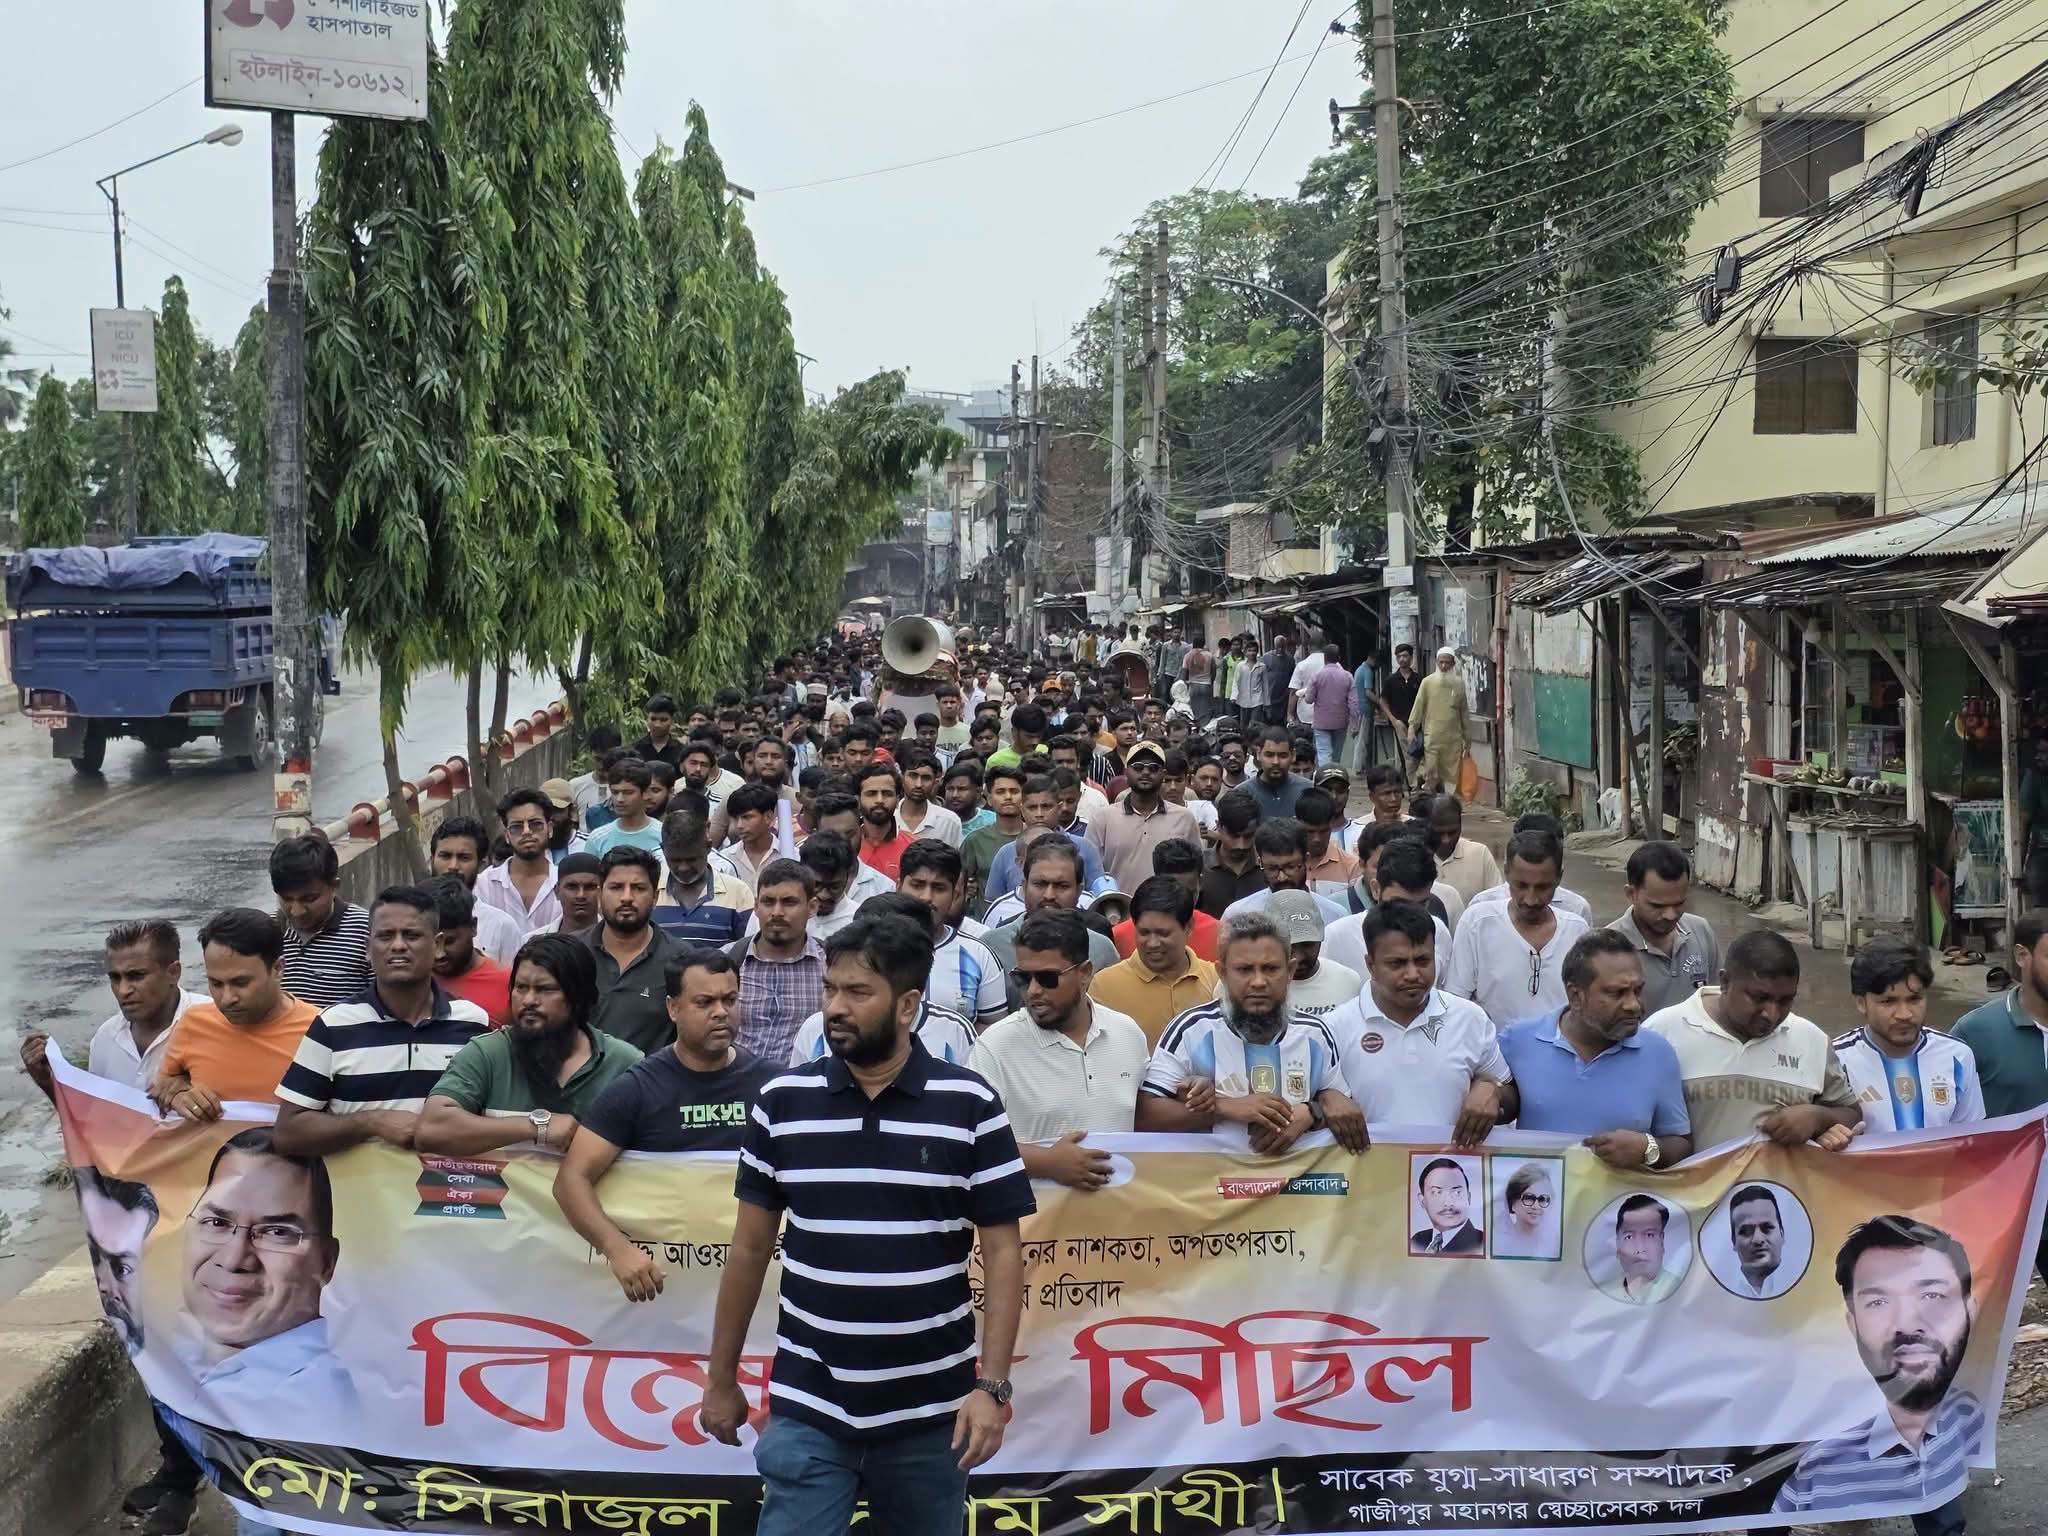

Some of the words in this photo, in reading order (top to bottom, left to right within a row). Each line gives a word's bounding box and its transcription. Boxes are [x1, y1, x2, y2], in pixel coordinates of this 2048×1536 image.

[305, 15, 393, 40] হাসপাতাল
[1225, 1179, 1281, 1196] বাংলাদেশ
[442, 1203, 477, 1215] প্রগতি
[1065, 1233, 1161, 1268] নাশকতা,
[1168, 1227, 1305, 1262] অপতৎপরতা,
[1040, 1272, 1125, 1312] প্রতিবাদ
[1070, 1309, 1490, 1436] মিছিল
[1318, 1468, 1416, 1492] সাবেক
[407, 1466, 732, 1536] সিরাজুল
[1348, 1498, 1432, 1526] গাজীপুর
[1440, 1500, 1529, 1521] মহানগর
[1537, 1499, 1661, 1521] স্বেচ্ছাসেবক
[1667, 1499, 1704, 1516] দল
